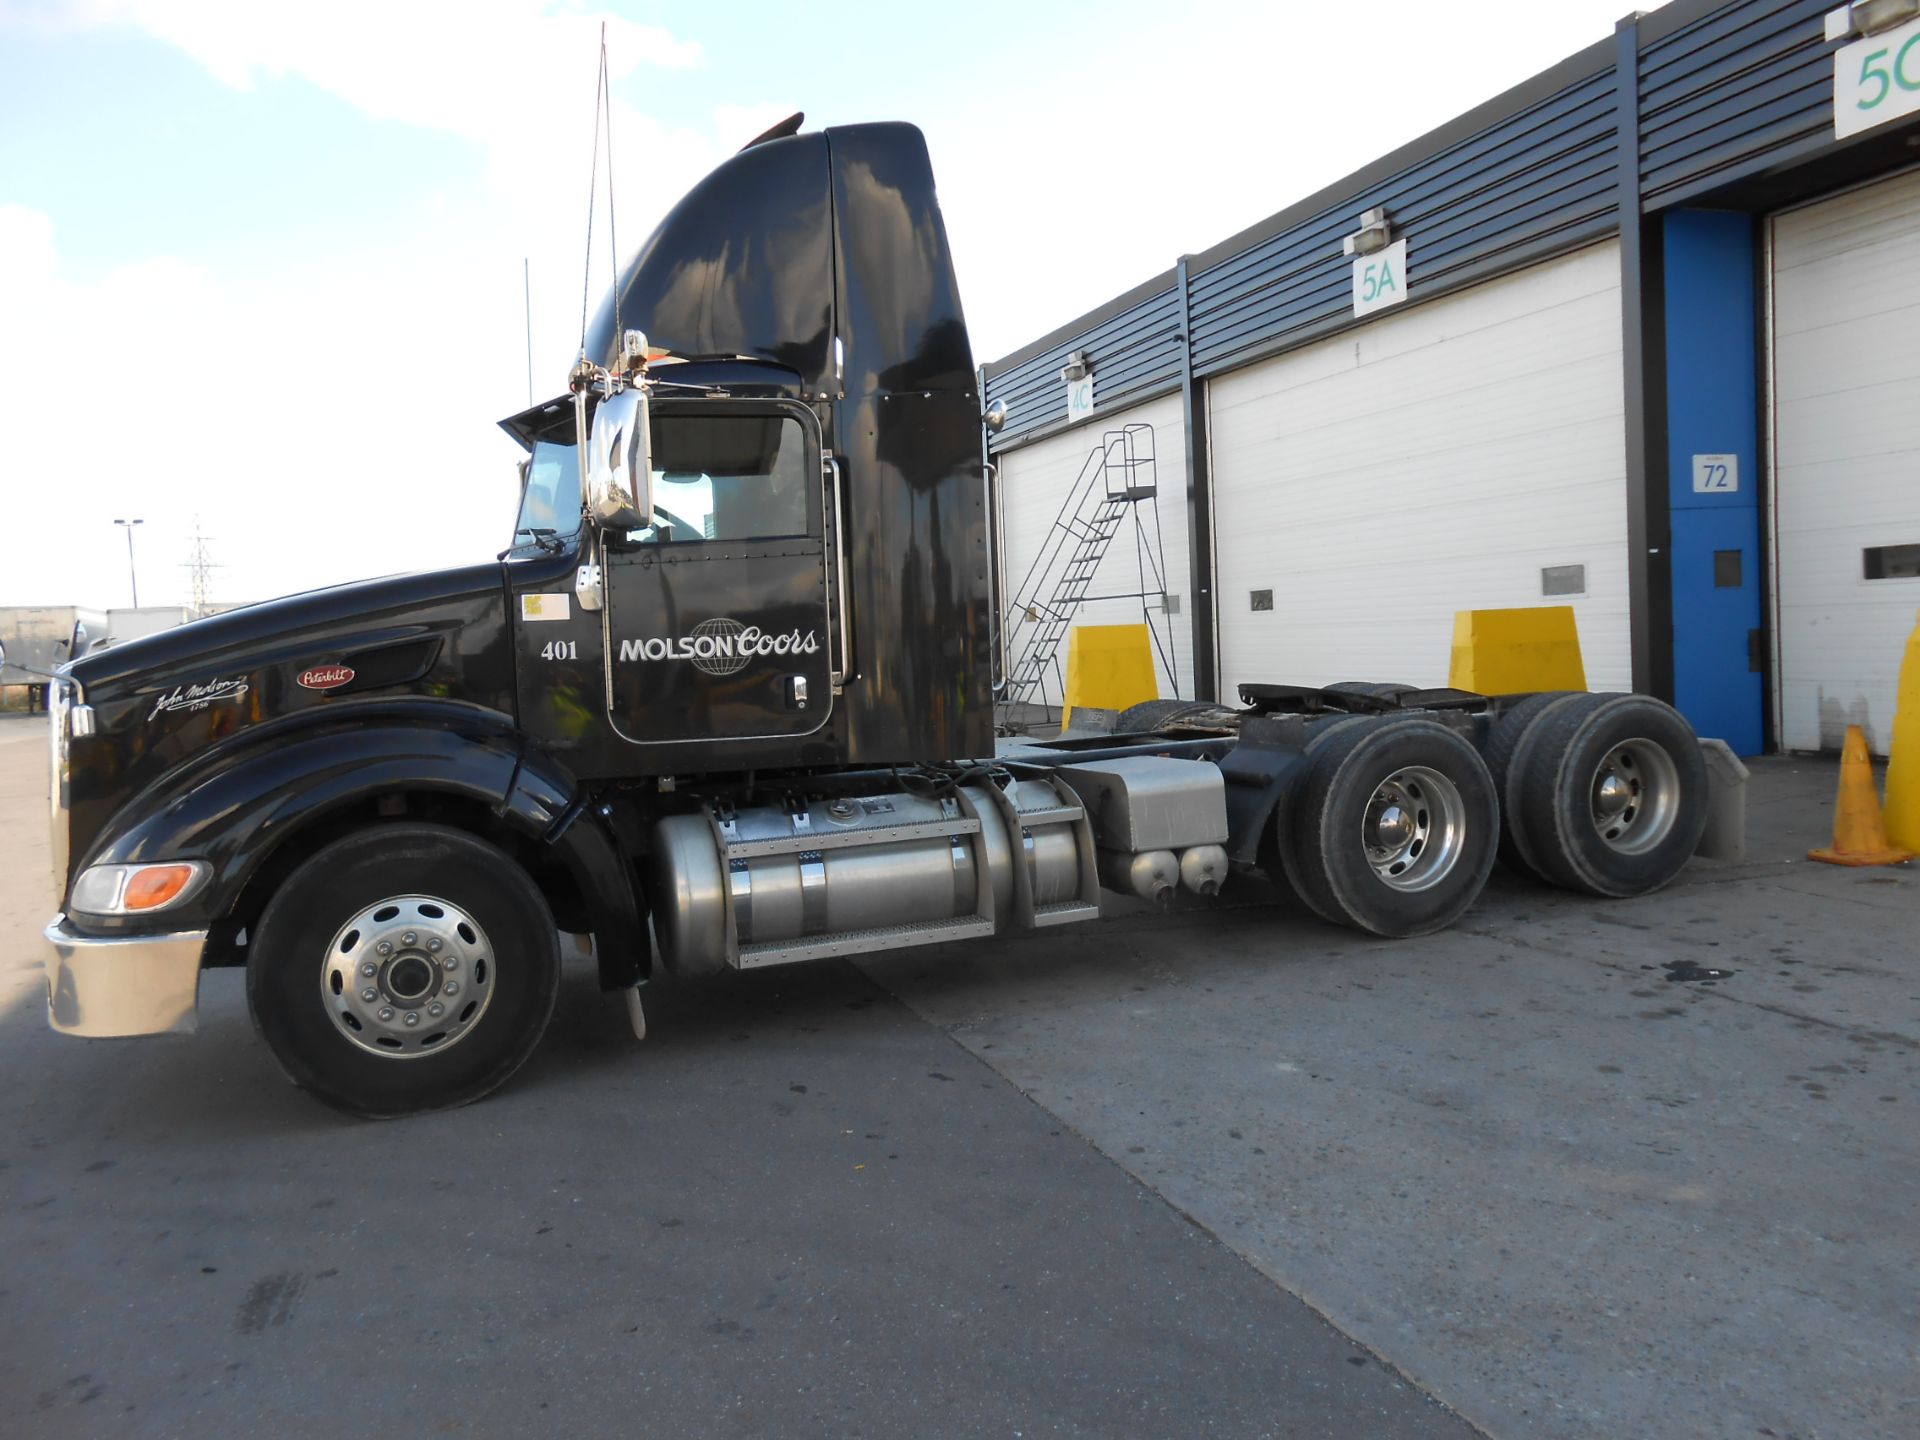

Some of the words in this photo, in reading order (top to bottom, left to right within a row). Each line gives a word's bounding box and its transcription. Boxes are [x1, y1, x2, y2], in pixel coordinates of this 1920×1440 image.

[1363, 259, 1396, 302] 5A
[1072, 383, 1089, 410] 4C
[1703, 464, 1728, 488] 72
[541, 640, 579, 661] 401
[619, 636, 734, 662] MOLSON
[734, 625, 820, 656] Coors
[304, 669, 349, 684] Peterbilt
[147, 686, 183, 722] John
